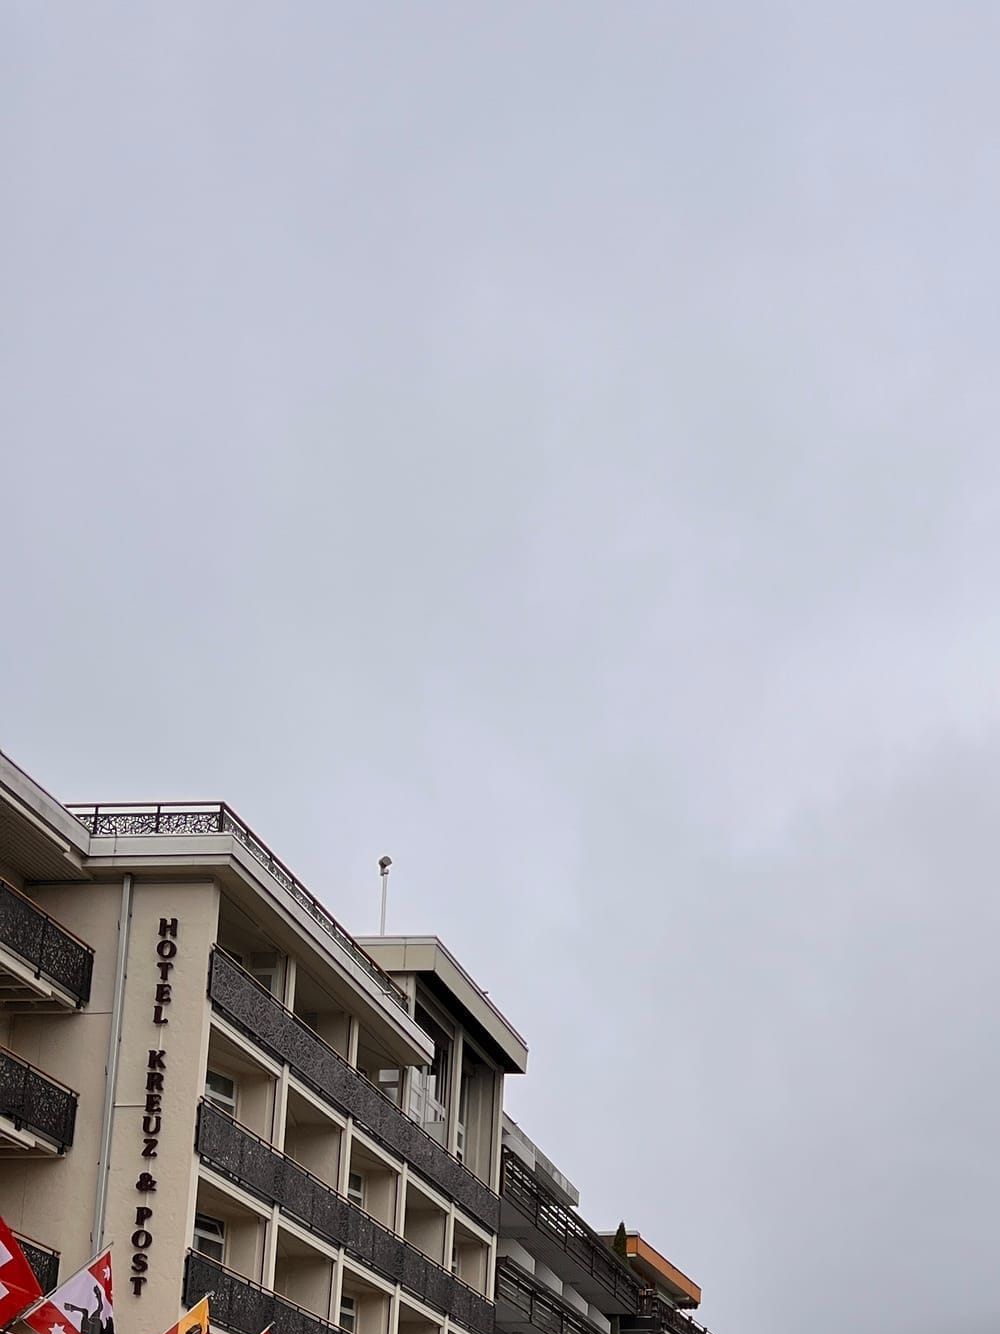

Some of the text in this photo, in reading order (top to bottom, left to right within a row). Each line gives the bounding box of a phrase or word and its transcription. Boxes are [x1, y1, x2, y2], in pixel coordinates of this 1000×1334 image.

[130, 917, 179, 1297] HOTEL KREUZ & POST
